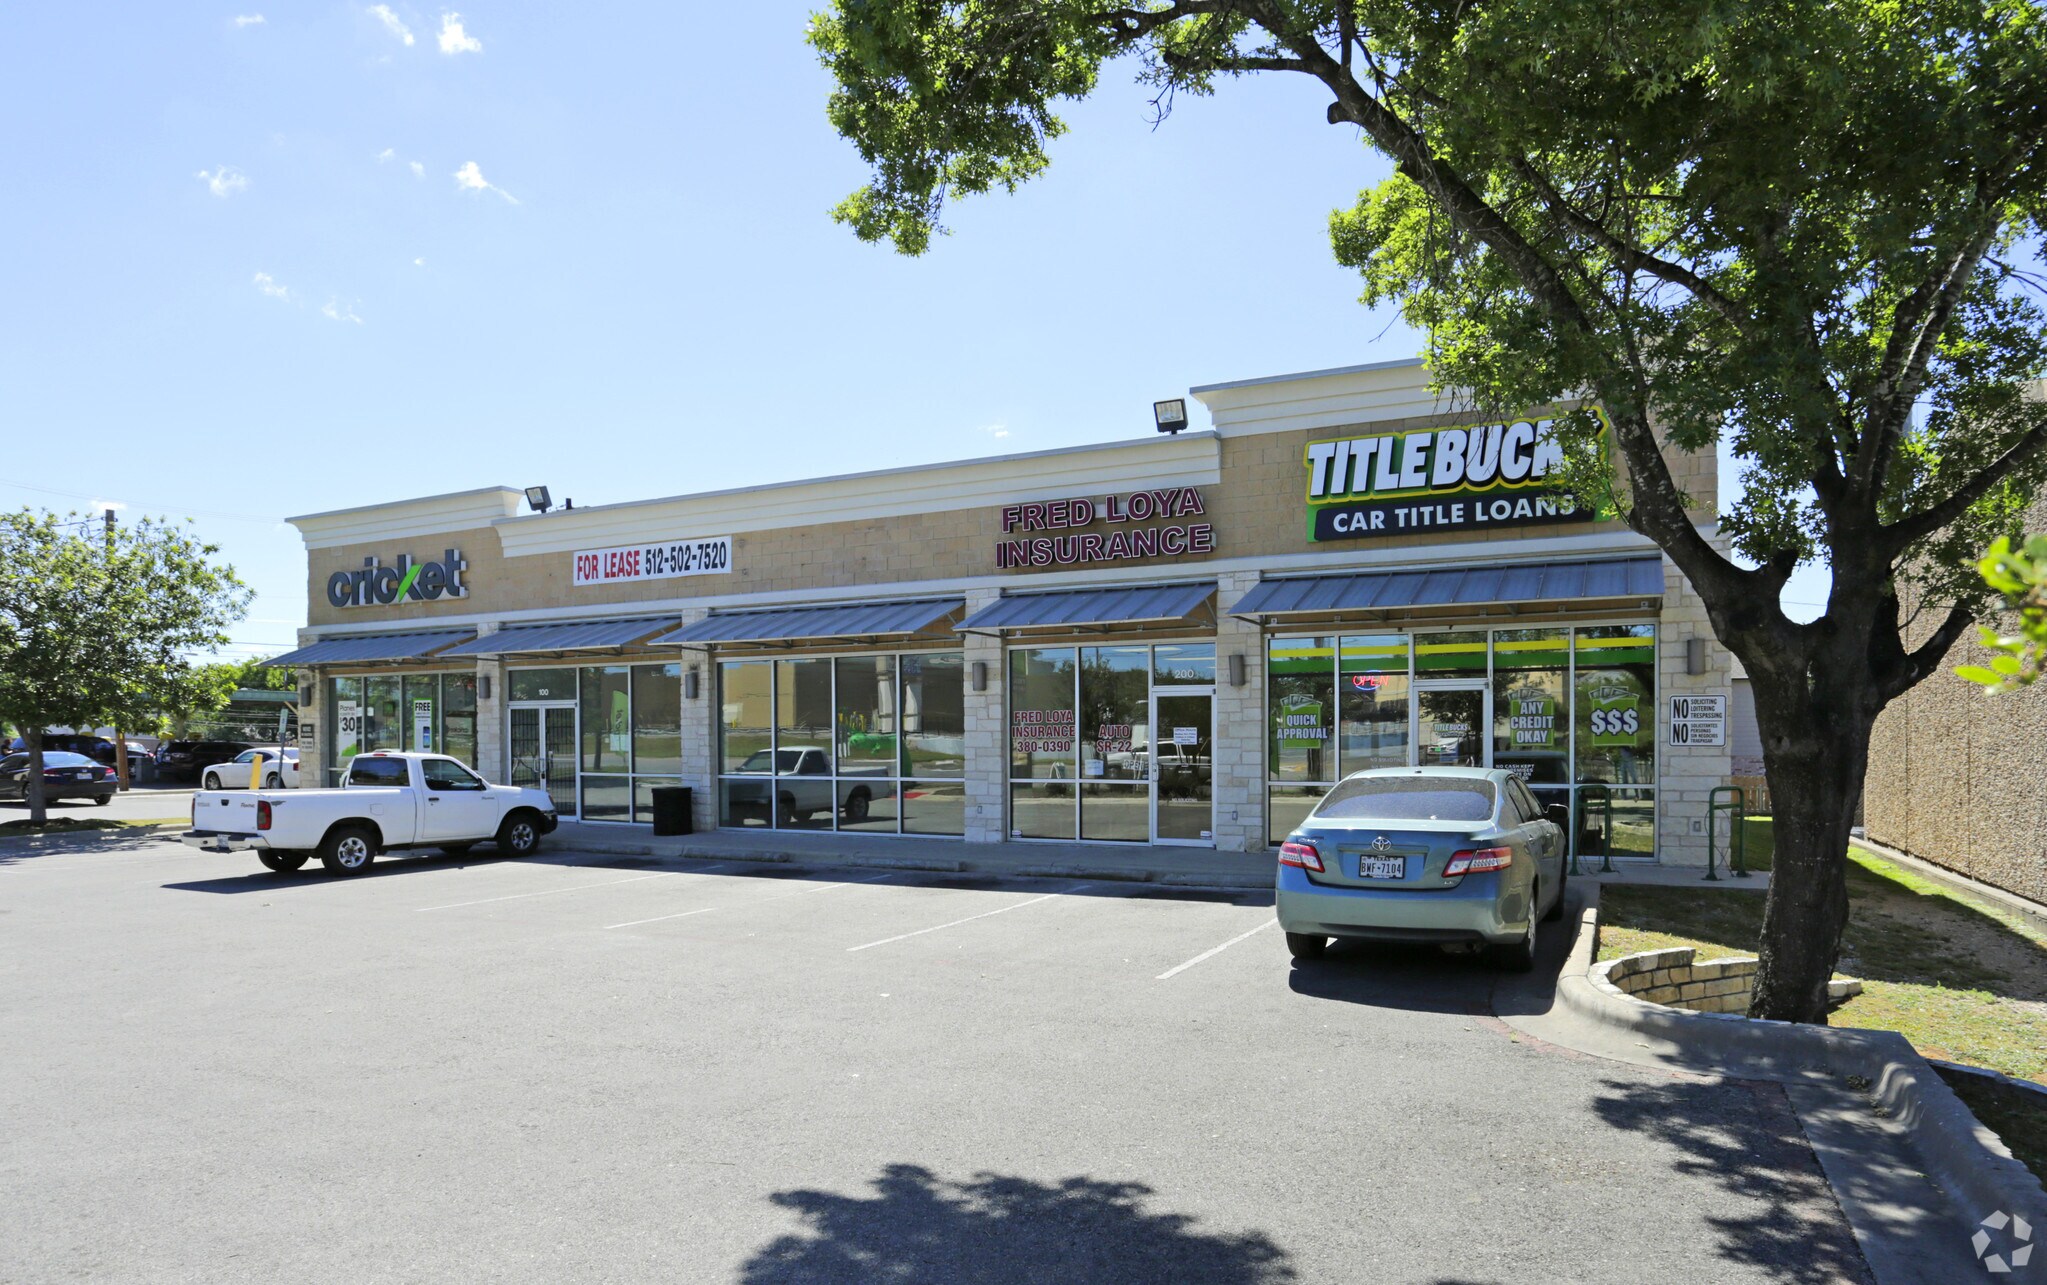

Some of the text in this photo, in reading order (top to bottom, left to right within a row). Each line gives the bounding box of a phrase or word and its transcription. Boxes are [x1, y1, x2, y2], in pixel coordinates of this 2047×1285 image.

[1308, 410, 1600, 497] TITLEBUCK
[1002, 487, 1204, 534] FRED LOYA
[1333, 494, 1575, 533] CAR TITLE LOANS
[995, 523, 1212, 569] INSURANCE
[577, 541, 727, 580] FOR LEASE 512-502-7520
[327, 549, 465, 607] cricket
[1175, 669, 1194, 679] 200
[1352, 675, 1390, 687] OPEN
[415, 702, 432, 712] FREE
[1520, 702, 1545, 715] ANY
[1673, 699, 1689, 719] NO
[1014, 710, 1074, 723] FRED LOYA
[1286, 714, 1317, 726] QUICK
[1510, 716, 1554, 729] CREDIT
[1012, 725, 1076, 738] INSURANCE
[1098, 724, 1131, 738] AUTO
[1276, 728, 1328, 739] APPROVAL
[1516, 730, 1548, 743] OKAY
[1673, 723, 1689, 743] NO
[1017, 741, 1071, 752] 380-0390
[1097, 740, 1132, 752] SR-22
